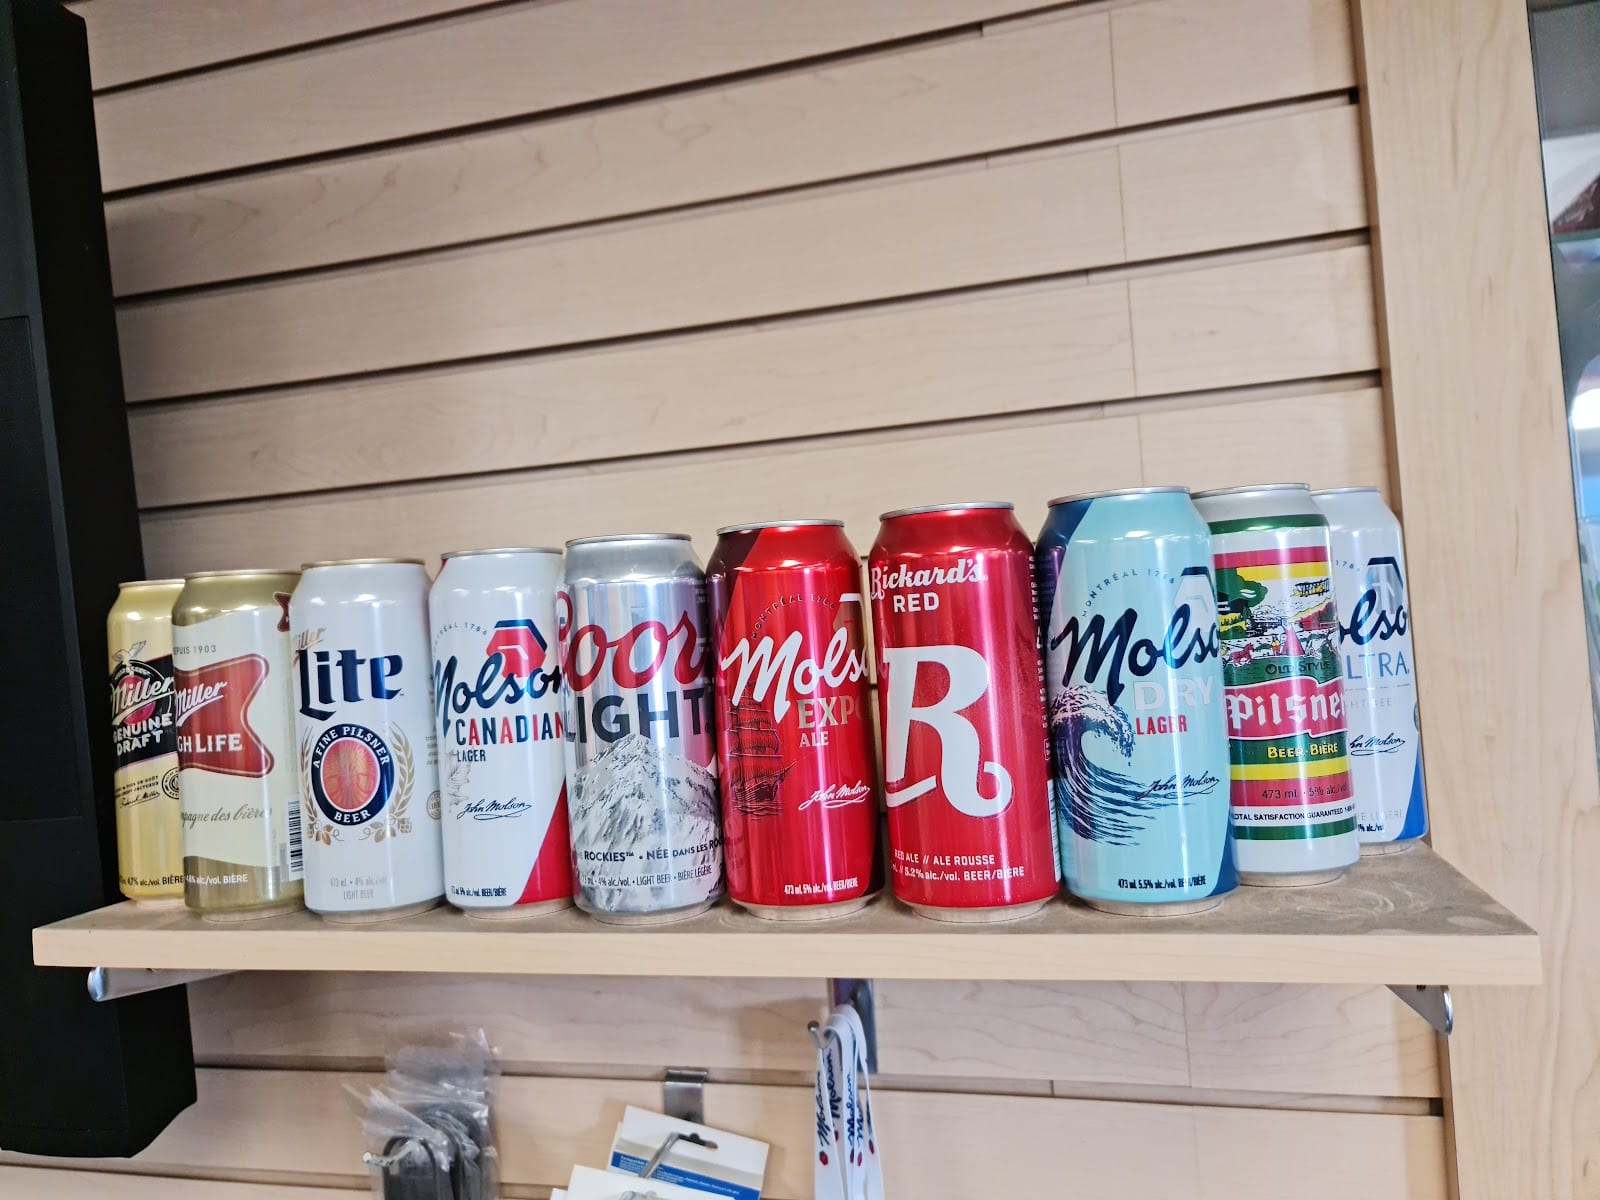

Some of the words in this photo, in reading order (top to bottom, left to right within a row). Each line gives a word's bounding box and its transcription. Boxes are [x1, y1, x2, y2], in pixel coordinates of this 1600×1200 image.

[871, 558, 984, 600] Rickard's
[893, 591, 940, 613] RED
[173, 646, 190, 655] EPUIS
[193, 644, 217, 654] 1903
[720, 626, 868, 724] Mols
[1265, 662, 1294, 676] OLD
[1298, 659, 1332, 673] STYLE
[1345, 650, 1410, 680] LTRA
[296, 648, 404, 721] Lite
[1133, 675, 1216, 711] DRY
[110, 676, 174, 719] Miller
[175, 681, 227, 719] Miller
[797, 694, 863, 730] EXP
[113, 713, 173, 744] GENUINE
[882, 644, 1013, 818] R
[1135, 714, 1188, 736] LAGER
[116, 729, 164, 756] DRAFT
[177, 735, 193, 753] GH
[195, 733, 243, 753] LIFE
[316, 729, 338, 756] FINE
[342, 726, 390, 765] PILSNER
[799, 731, 829, 748] ALE
[1267, 746, 1304, 759] BEER
[1309, 741, 1339, 756] BIÈRE
[456, 749, 487, 763] LAGER
[1262, 789, 1281, 799] 473
[181, 810, 210, 830] pagne
[211, 807, 230, 822] des
[334, 809, 371, 823] BEER
[1253, 812, 1305, 821] SATISFACTION
[1306, 807, 1344, 819] GUARANTEED
[646, 845, 669, 861] NÉE
[672, 846, 694, 858] DANS
[696, 843, 708, 854] LES
[894, 848, 905, 861] RED
[905, 853, 919, 864] ALE
[933, 855, 951, 866] ALE
[954, 854, 996, 866] ROUSSE
[223, 872, 249, 885] BIÈRE
[636, 876, 655, 886] LIGHT
[677, 869, 694, 881] BIÈRE
[904, 866, 924, 880] 5.2%
[925, 870, 961, 881] alc./vol.
